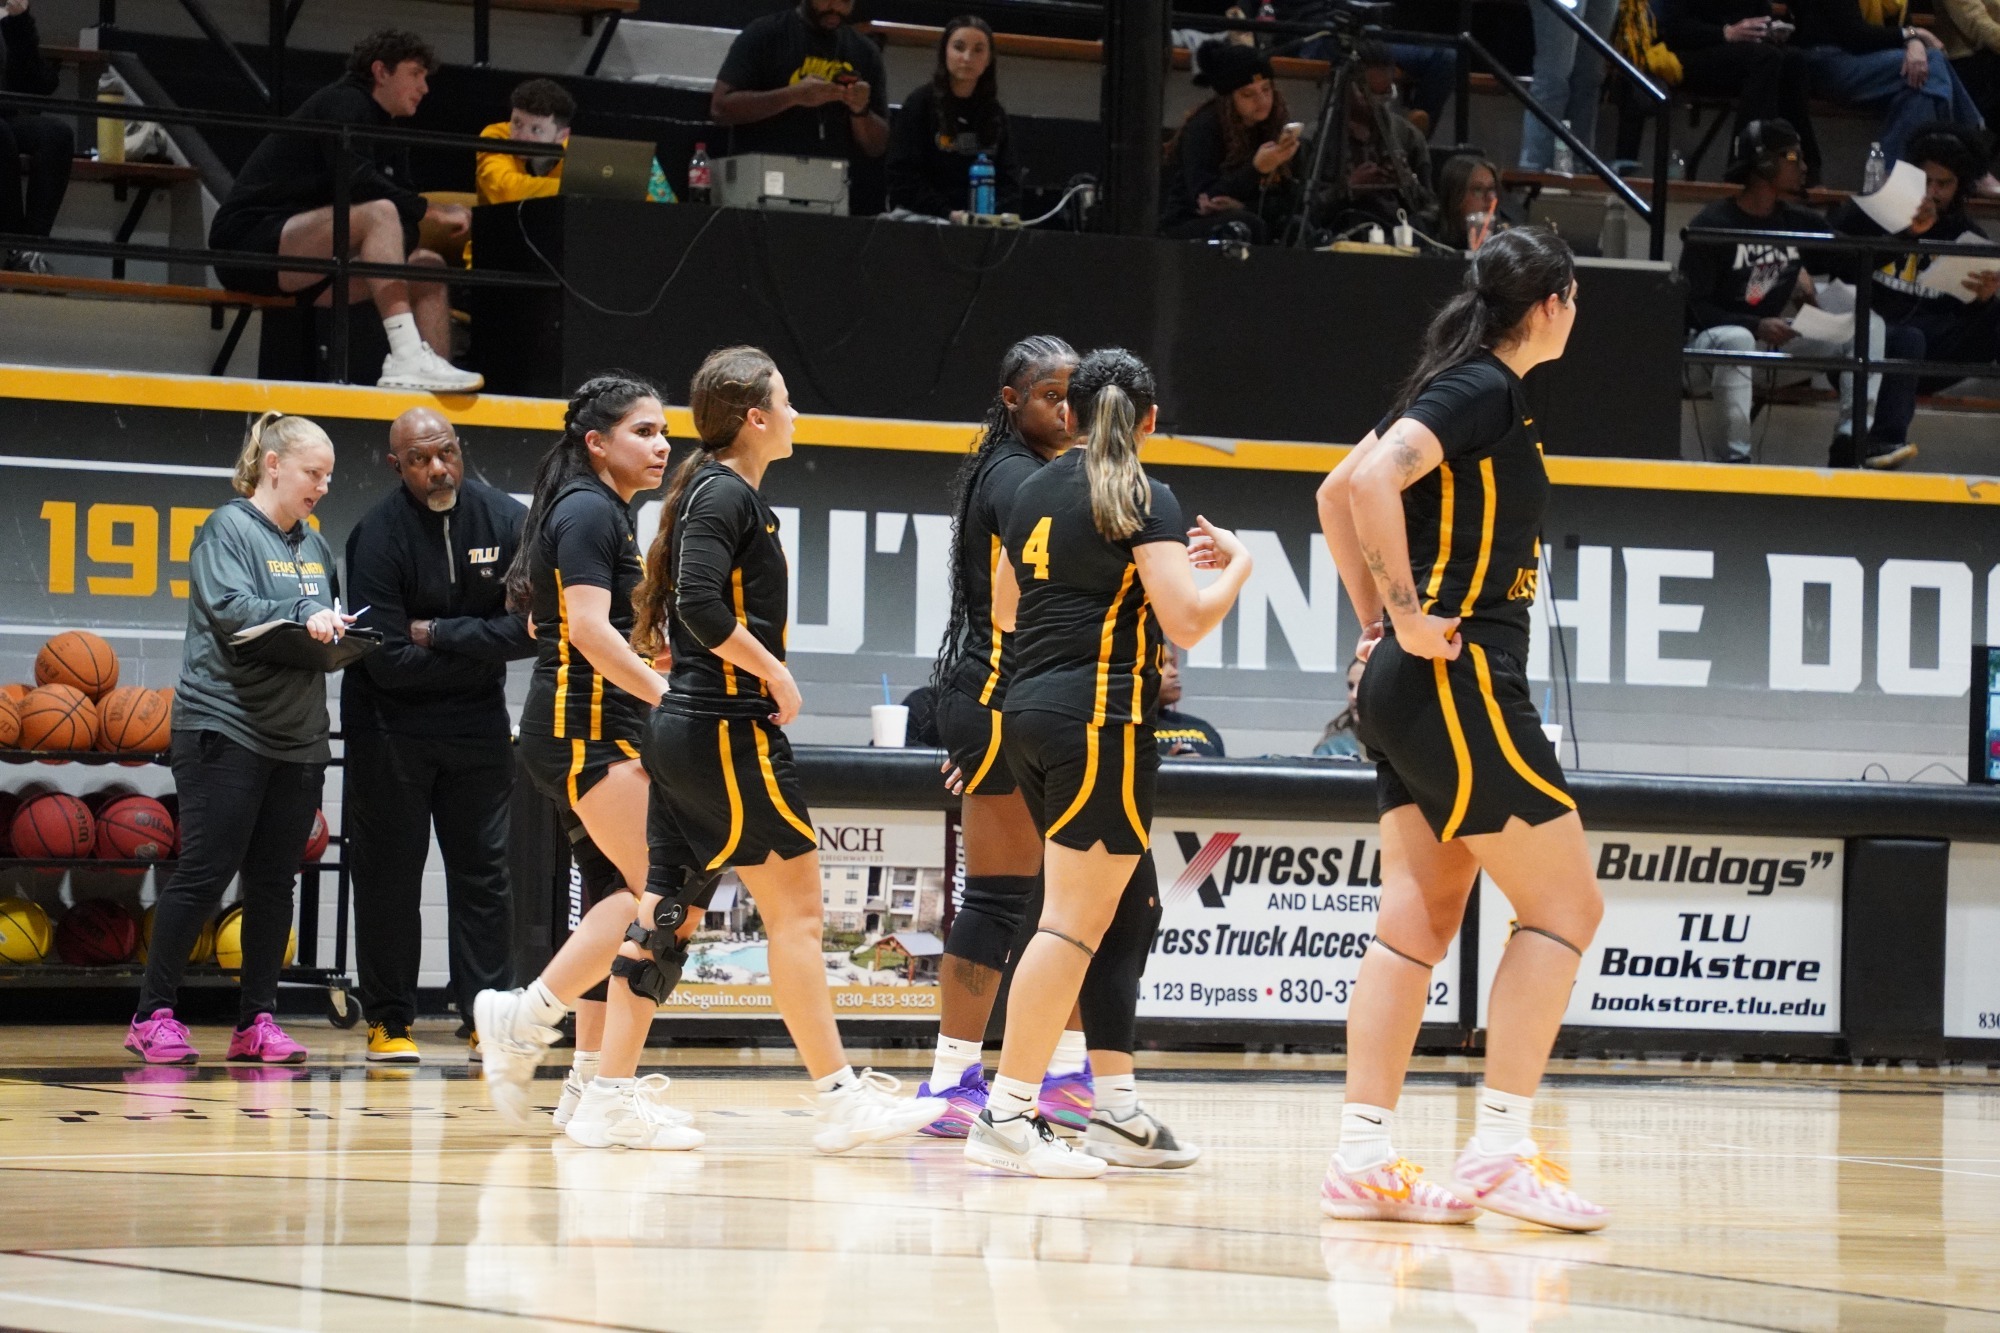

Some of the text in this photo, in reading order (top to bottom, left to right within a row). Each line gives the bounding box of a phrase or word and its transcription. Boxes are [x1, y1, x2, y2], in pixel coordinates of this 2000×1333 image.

[468, 546, 500, 564] TLU
[1022, 516, 1053, 580] 4
[266, 560, 297, 574] TEXAS
[1526, 543, 1714, 687] HE
[1766, 553, 2000, 697] DO
[817, 826, 884, 852] NCH
[1162, 831, 1343, 908] Xpress
[1267, 893, 1306, 911] AND
[1678, 913, 1750, 943] TLU
[1150, 924, 1377, 960] ress Truck Acces
[1600, 948, 1821, 982] Bookstore
[664, 990, 936, 1009] chSeguin.com 830-433-9323
[1153, 982, 1184, 1001] 123
[1190, 984, 1258, 1007] Bypass
[1591, 993, 1826, 1017] bookstore.tlu.edu
